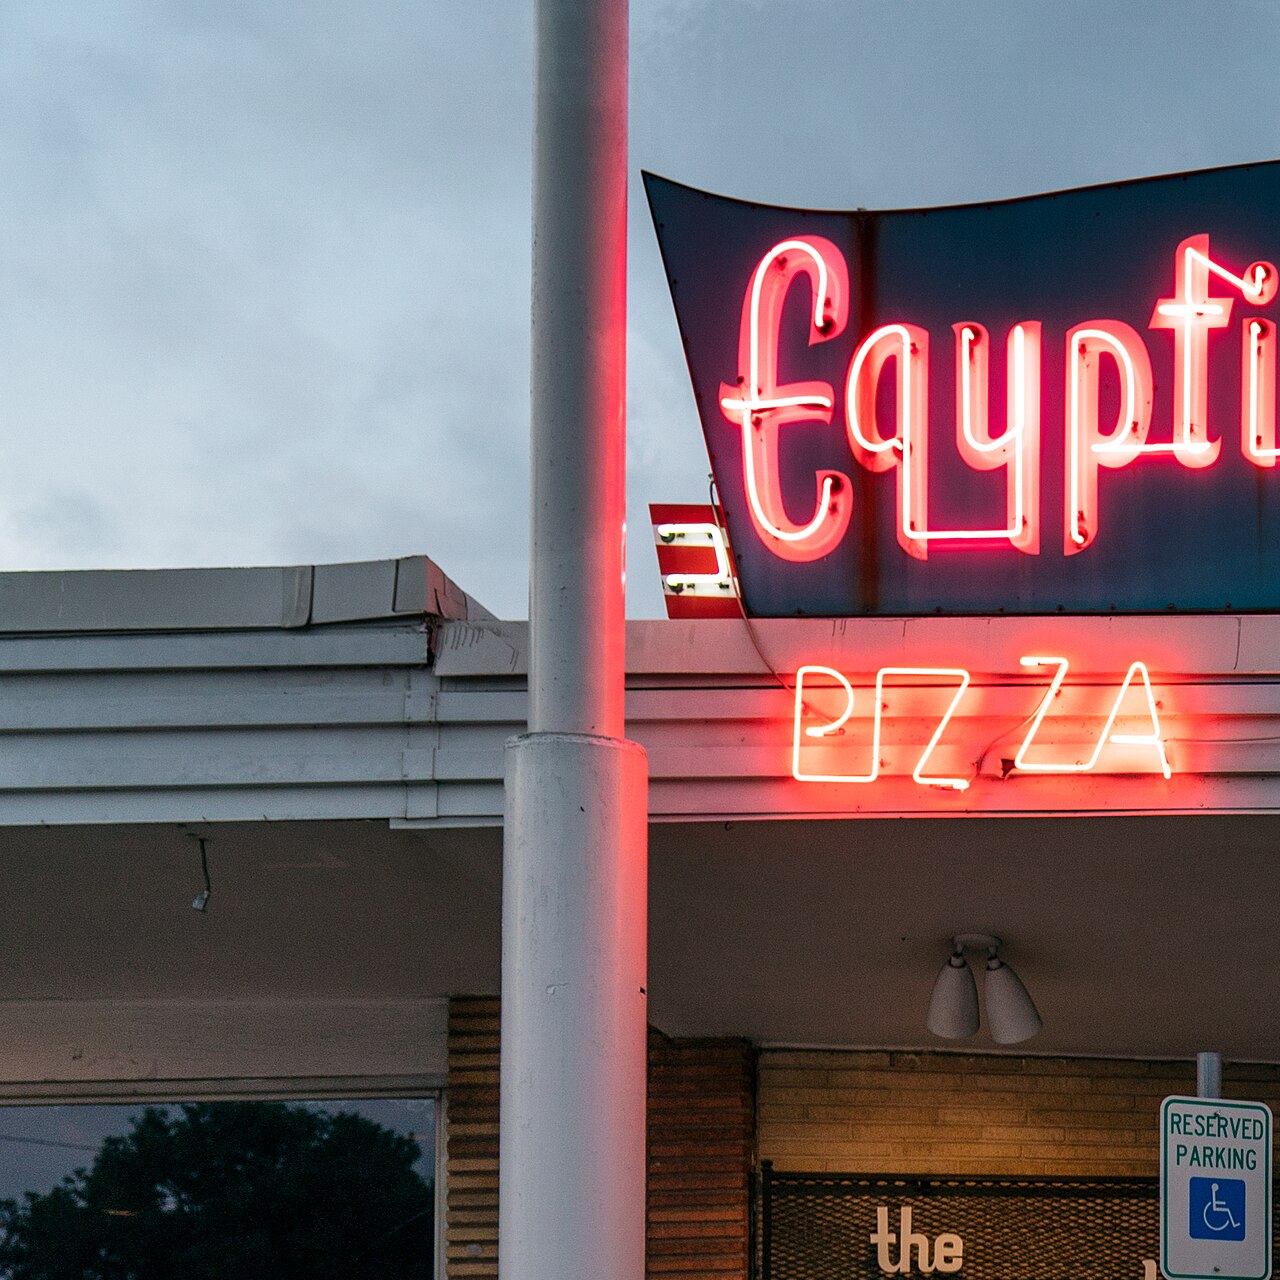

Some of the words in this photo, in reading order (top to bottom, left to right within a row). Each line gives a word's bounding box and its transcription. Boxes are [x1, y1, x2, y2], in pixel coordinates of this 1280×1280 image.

[792, 656, 1172, 791] PIZZA
[1170, 1112, 1264, 1141] RESERVED
[1176, 1144, 1257, 1171] PARKING
[870, 1206, 964, 1274] the
